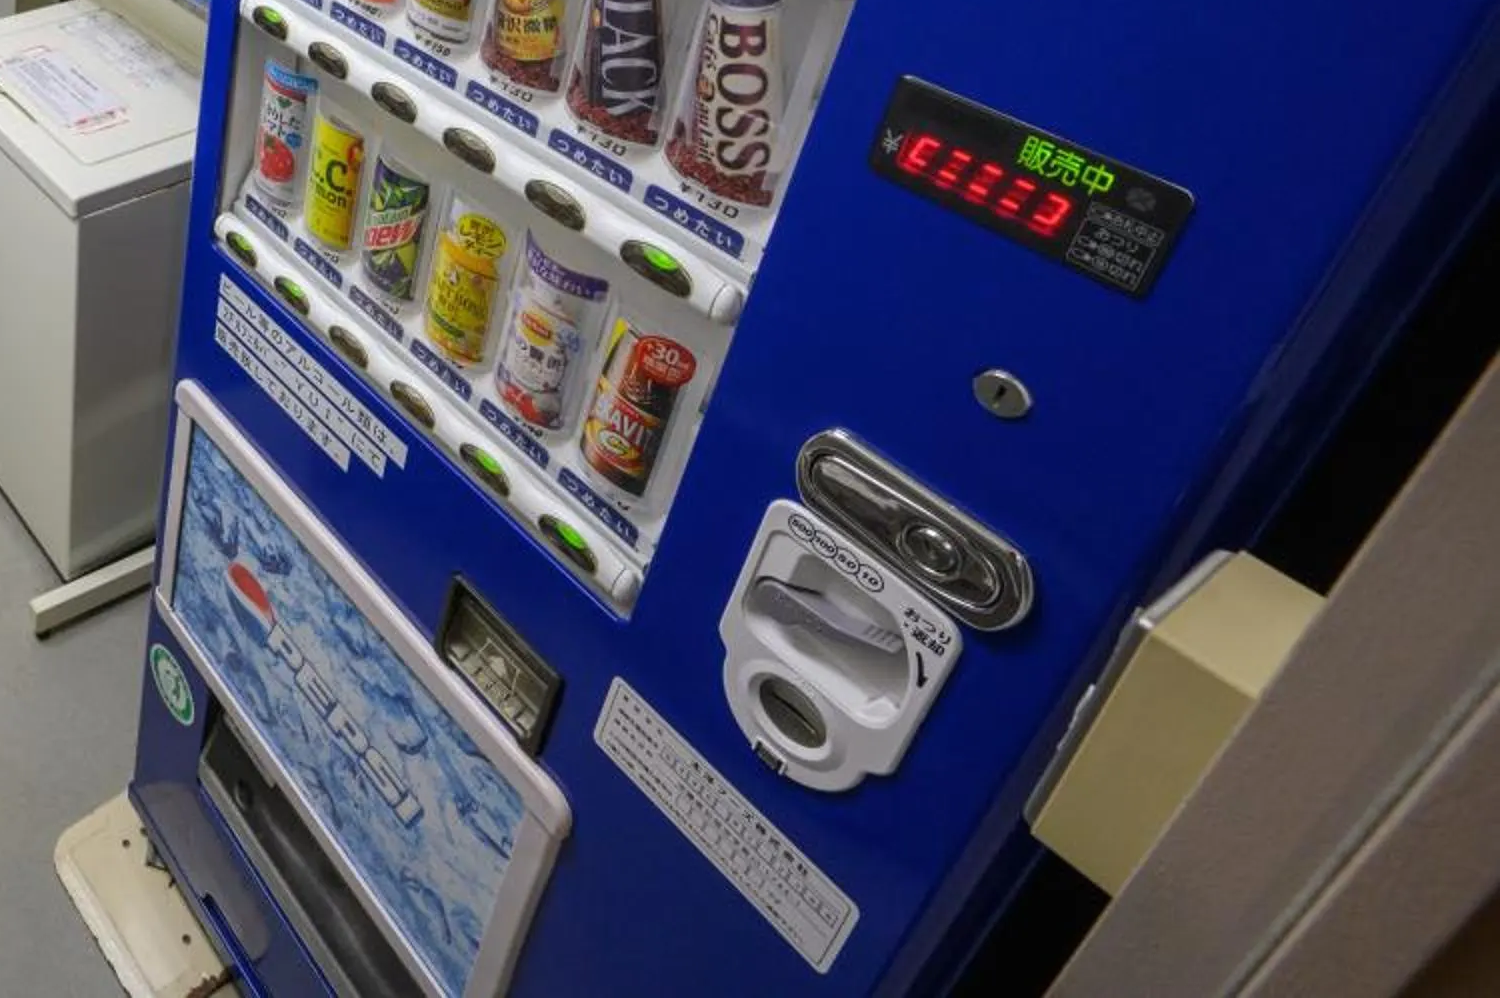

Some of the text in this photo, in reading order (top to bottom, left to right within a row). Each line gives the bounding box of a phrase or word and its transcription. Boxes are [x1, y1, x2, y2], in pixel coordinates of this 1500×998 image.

[472, 89, 533, 131] つめたい
[715, 15, 771, 172] BOSS
[555, 136, 627, 186] つめたい
[1017, 134, 1116, 195] 販売中
[652, 196, 735, 249] つめたい
[681, 181, 740, 220] ¥130
[267, 621, 425, 830] PEPSI
